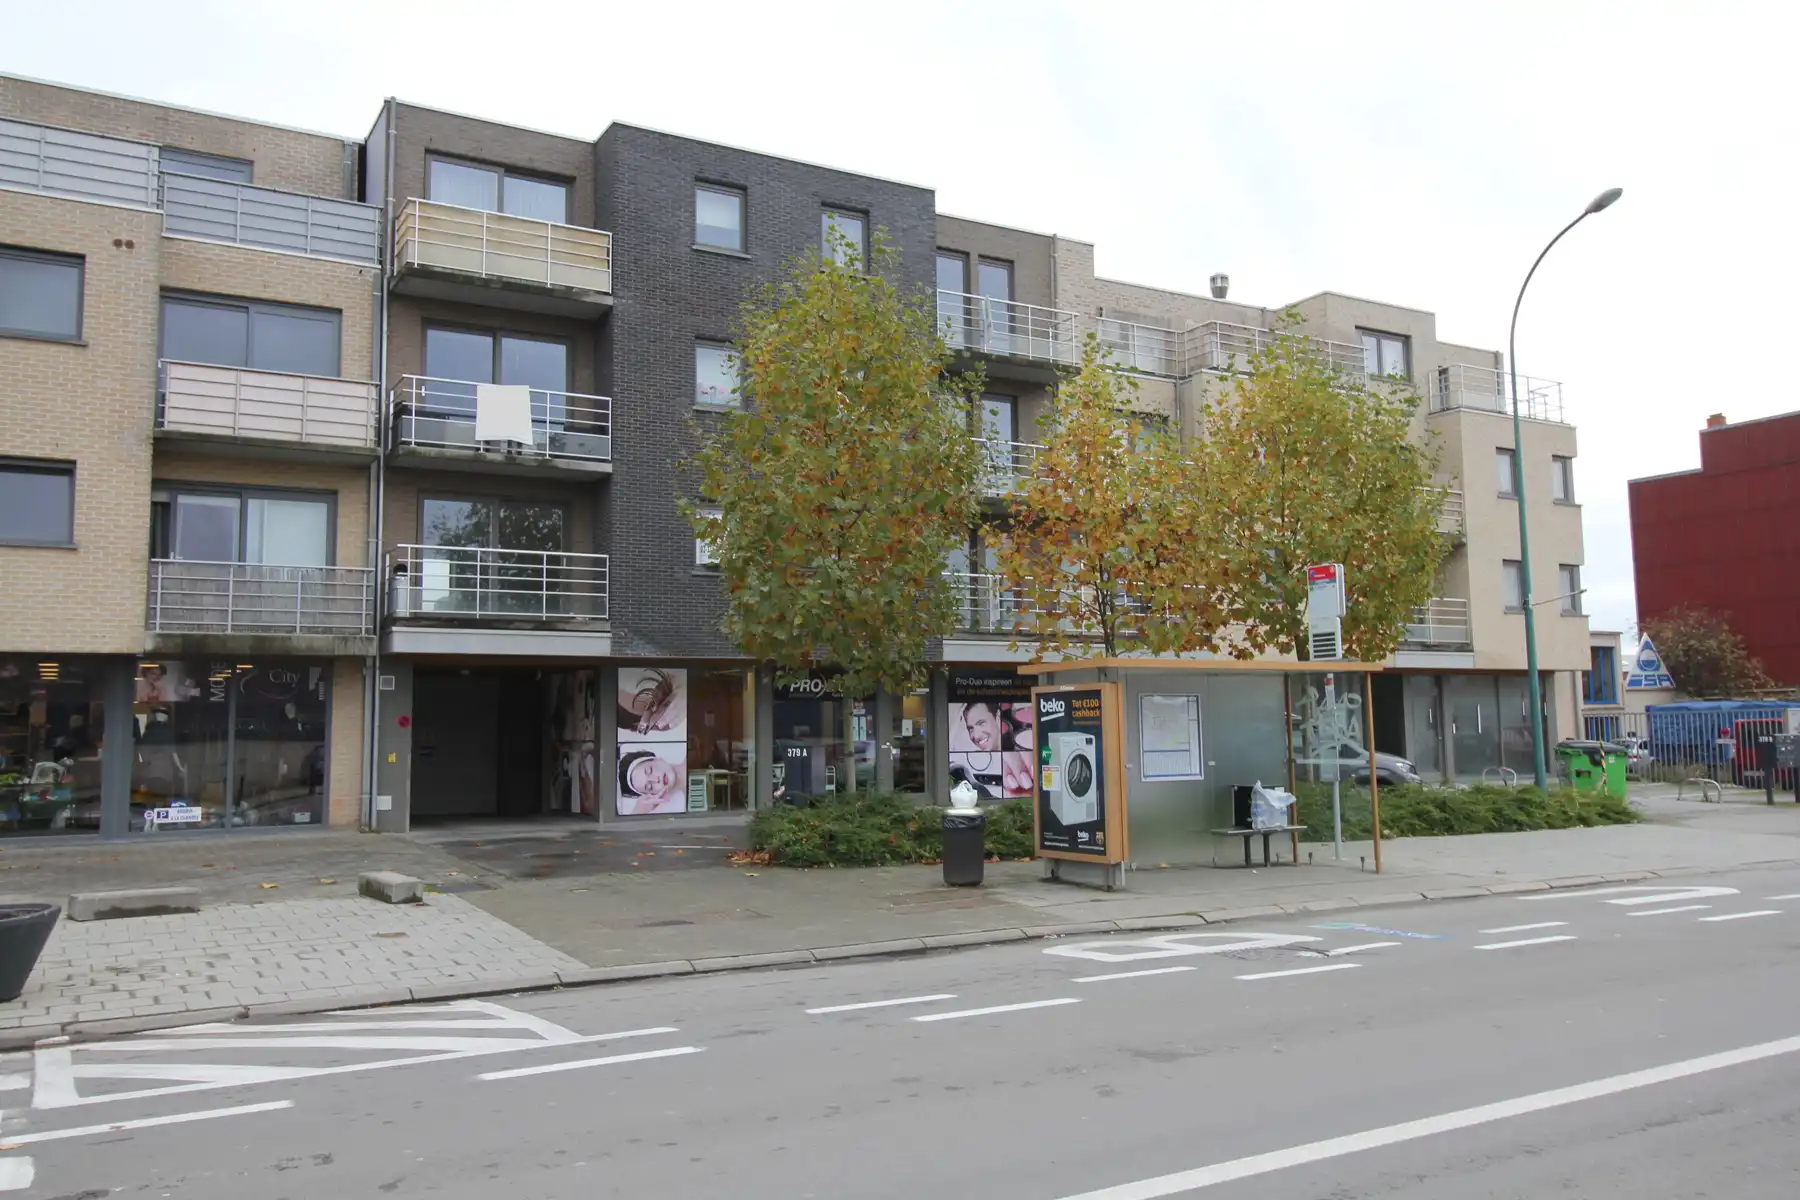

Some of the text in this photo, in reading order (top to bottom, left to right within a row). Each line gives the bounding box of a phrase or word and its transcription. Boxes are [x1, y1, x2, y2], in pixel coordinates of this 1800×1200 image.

[269, 668, 300, 688] City
[1040, 698, 1065, 712] beko
[1071, 698, 1100, 708] Tot €100
[1071, 709, 1100, 717] cashback
[787, 748, 808, 757] 379 A
[160, 811, 167, 819] P
